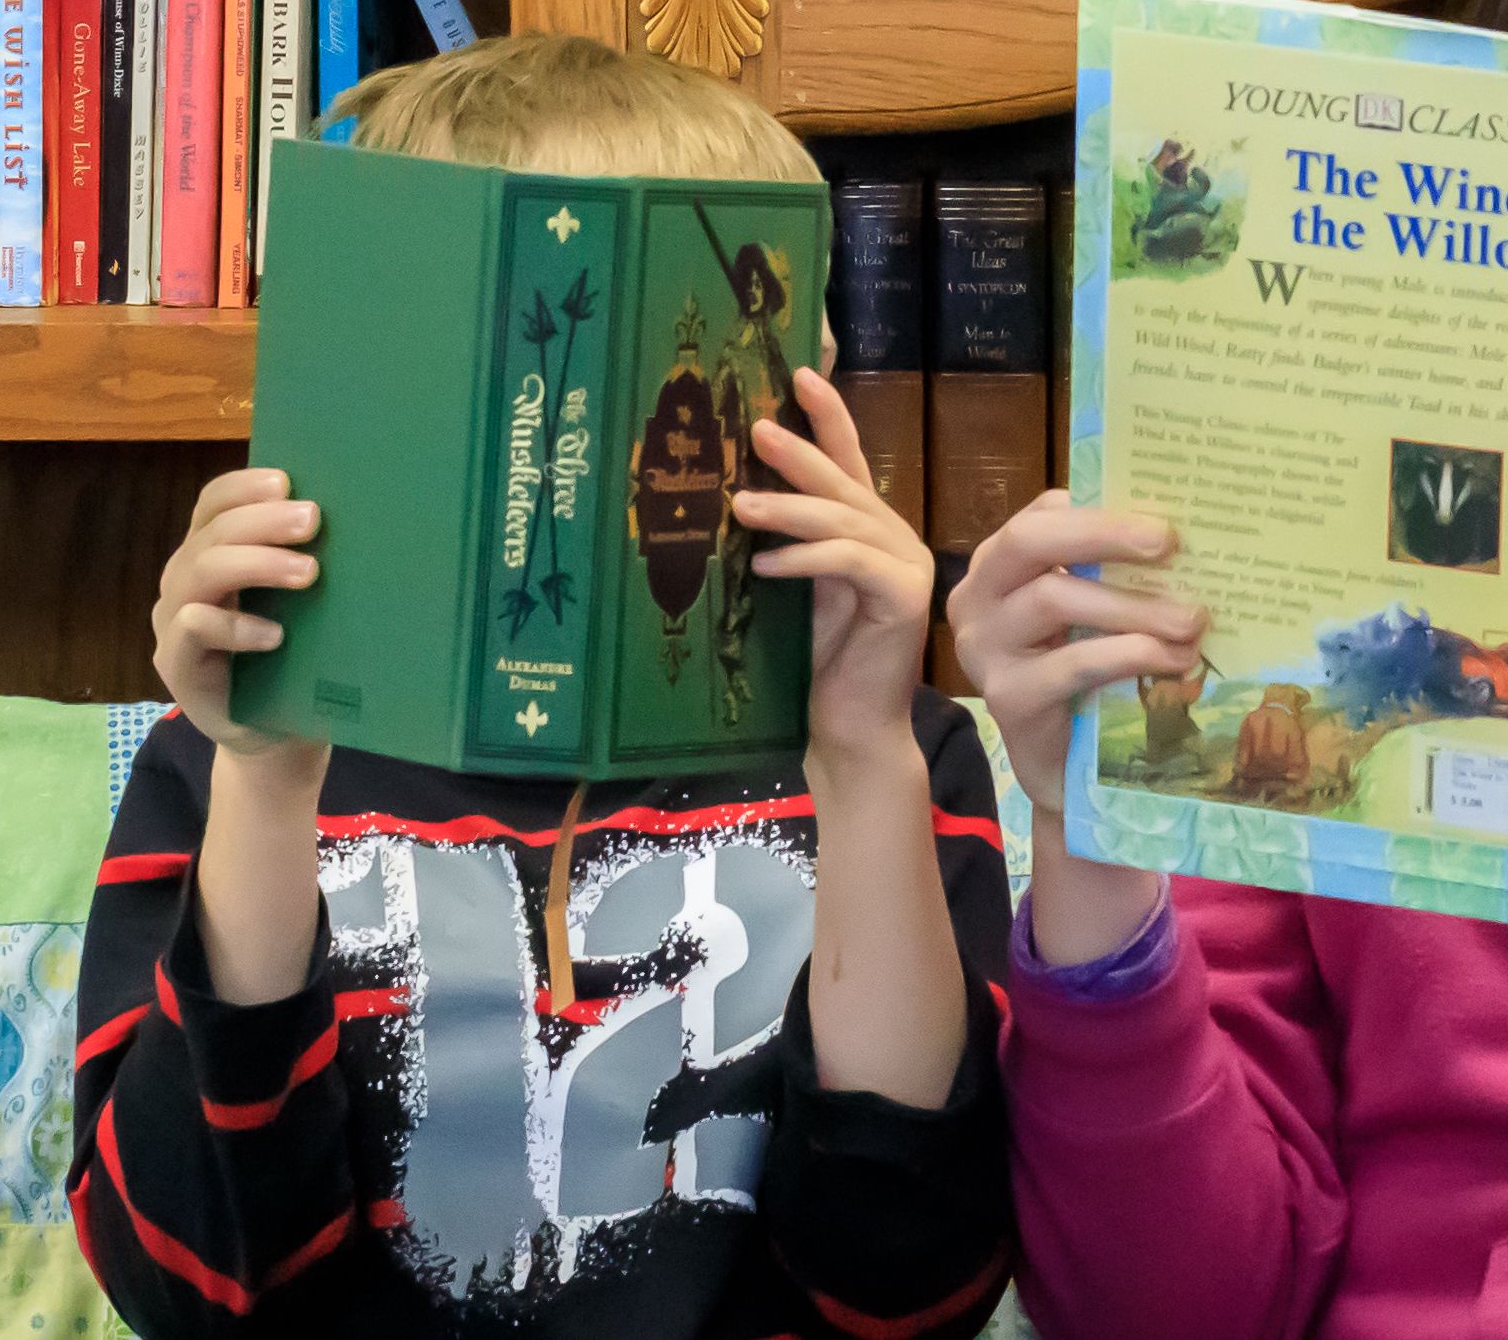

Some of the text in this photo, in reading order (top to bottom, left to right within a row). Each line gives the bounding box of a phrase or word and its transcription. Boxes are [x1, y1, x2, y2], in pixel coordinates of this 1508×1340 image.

[4, 27, 30, 110] WISH
[69, 22, 92, 187] Gone-Away Lake
[1224, 81, 1349, 123] YOUNG
[4, 124, 30, 191] LIST
[1286, 148, 1379, 198] The
[1291, 205, 1365, 251] the
